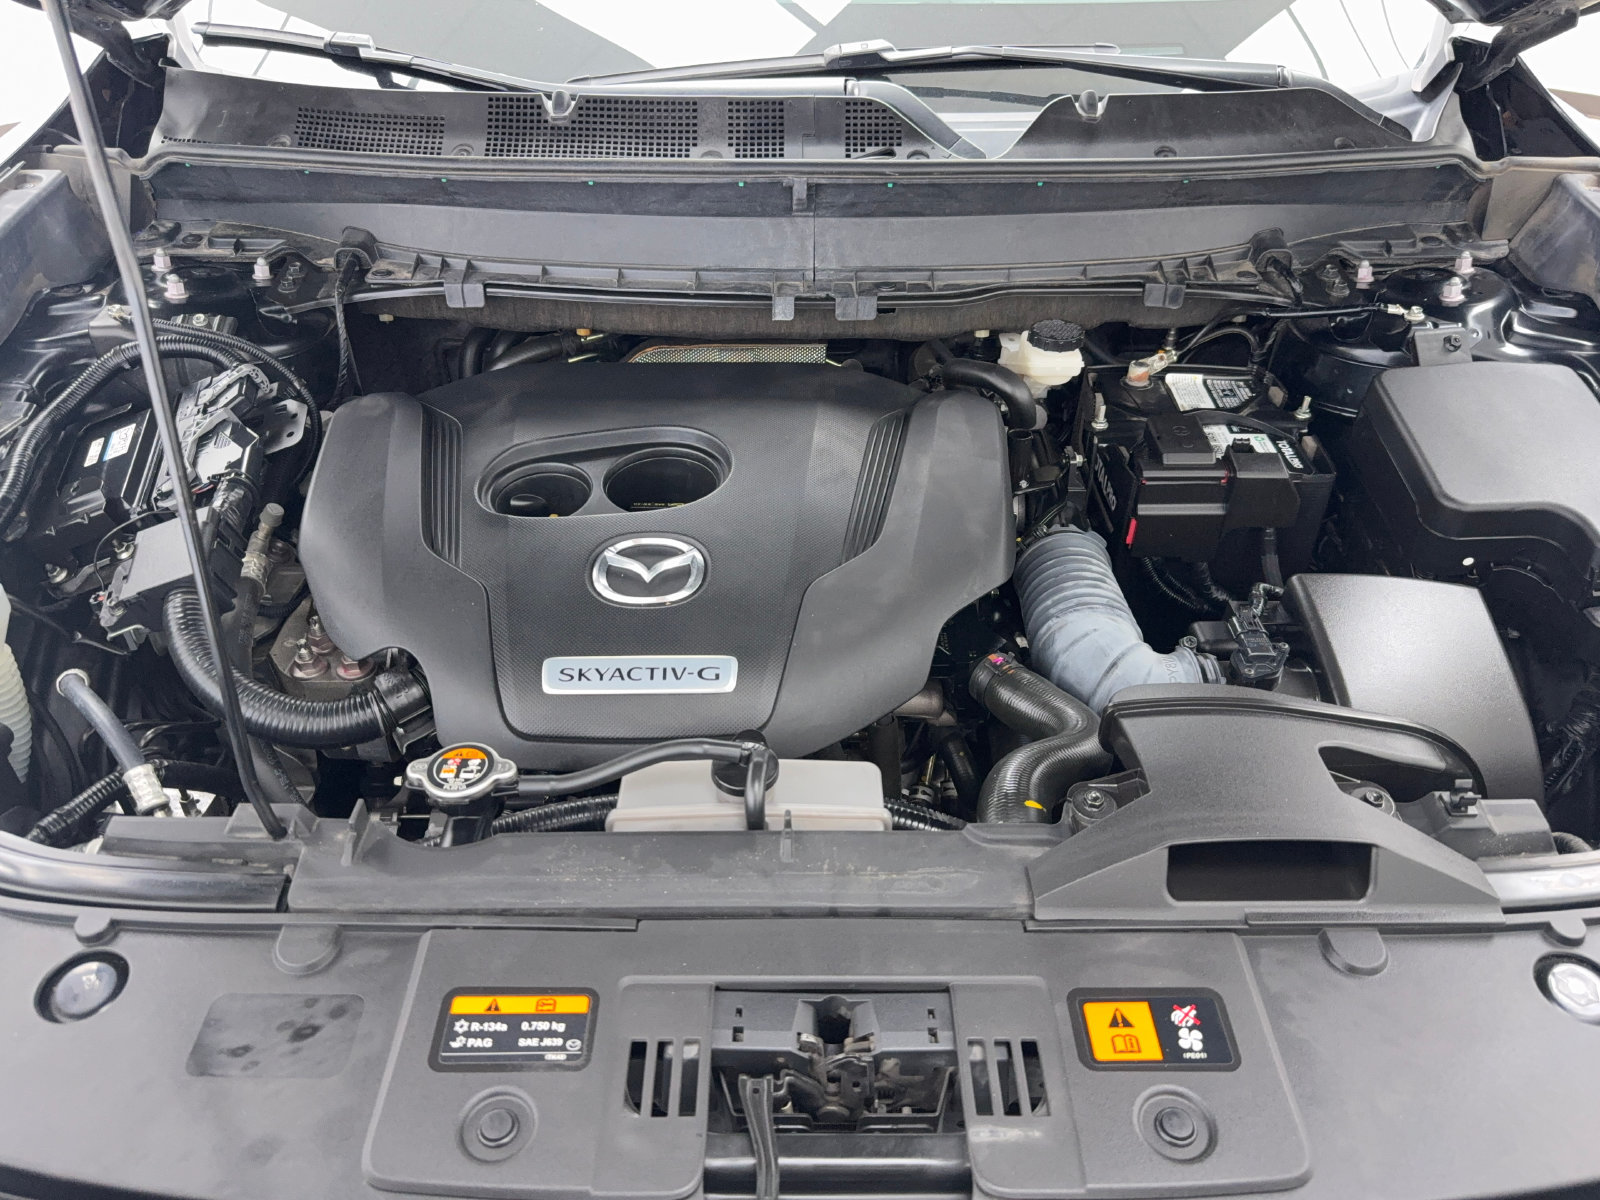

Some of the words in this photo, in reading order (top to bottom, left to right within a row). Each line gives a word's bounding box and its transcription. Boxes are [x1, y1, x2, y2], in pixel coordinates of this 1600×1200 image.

[558, 666, 720, 682] SKYACTIV-G
[470, 1021, 508, 1032] R-134a
[520, 1021, 549, 1031] 0.750
[551, 1021, 566, 1032] kg
[466, 1038, 493, 1048] PAG
[518, 1037, 540, 1047] SAE
[540, 1037, 564, 1047] J639
